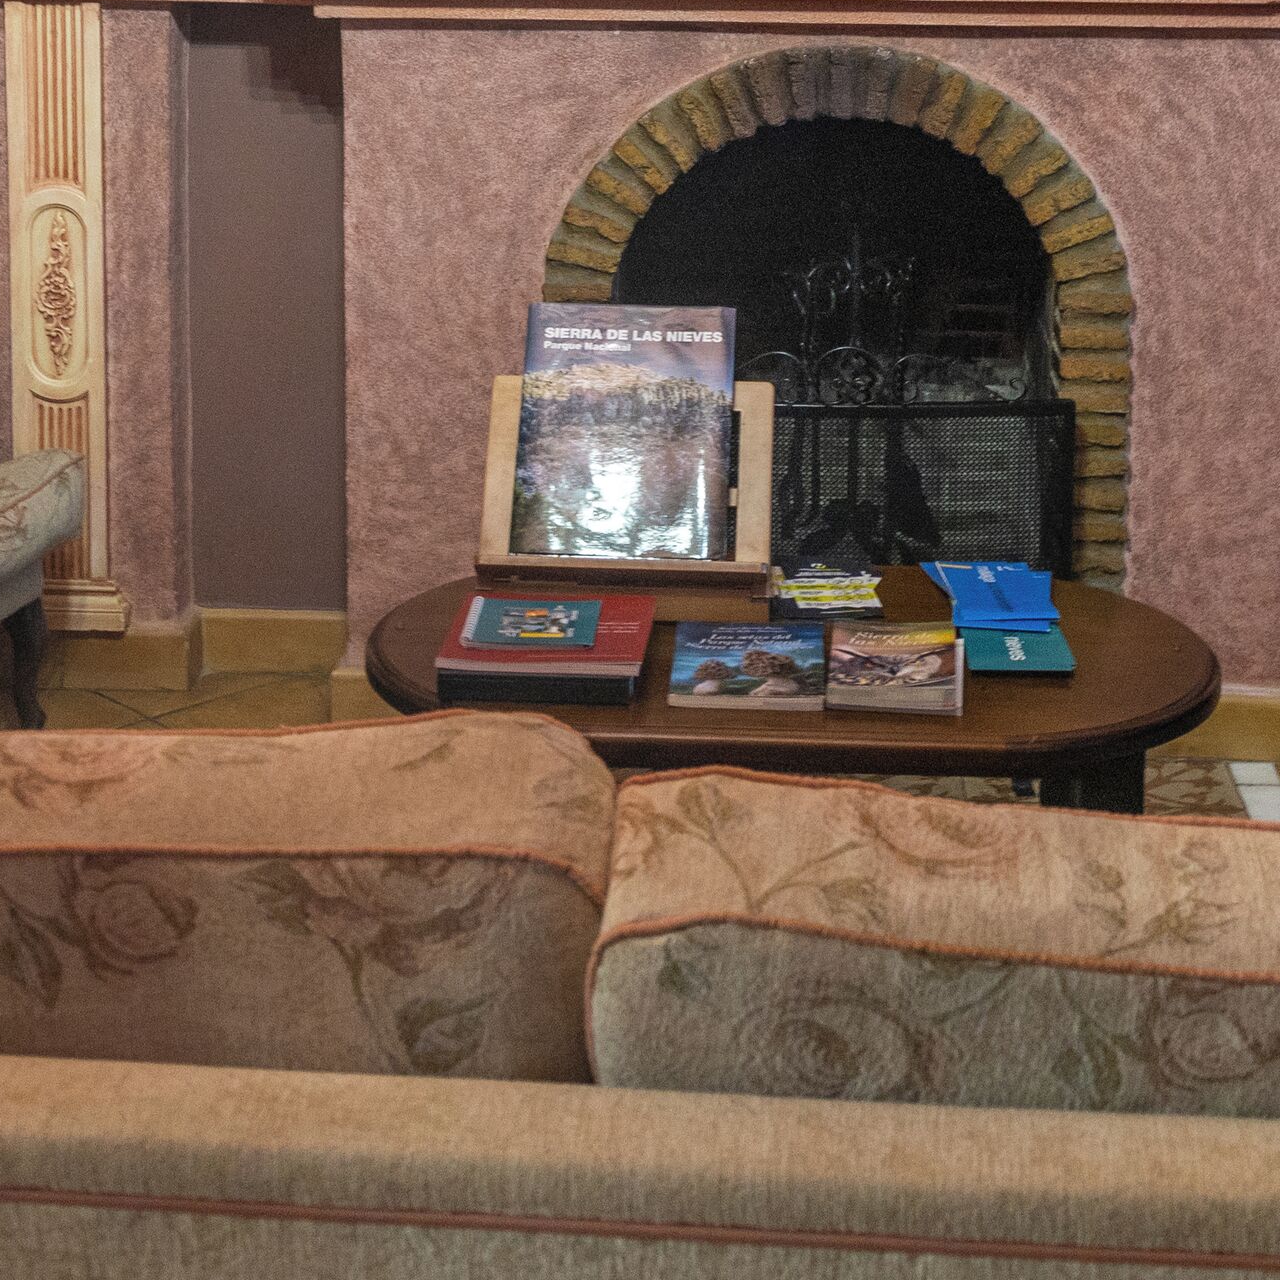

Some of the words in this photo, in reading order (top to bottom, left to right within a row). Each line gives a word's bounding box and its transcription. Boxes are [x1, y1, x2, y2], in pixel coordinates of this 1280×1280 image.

[544, 327, 602, 340] SIERRA
[607, 329, 629, 340] DE
[632, 330, 663, 342] LAS
[666, 331, 723, 343] NIEVES
[544, 340, 582, 350] Parque
[584, 341, 631, 352] Nacional
